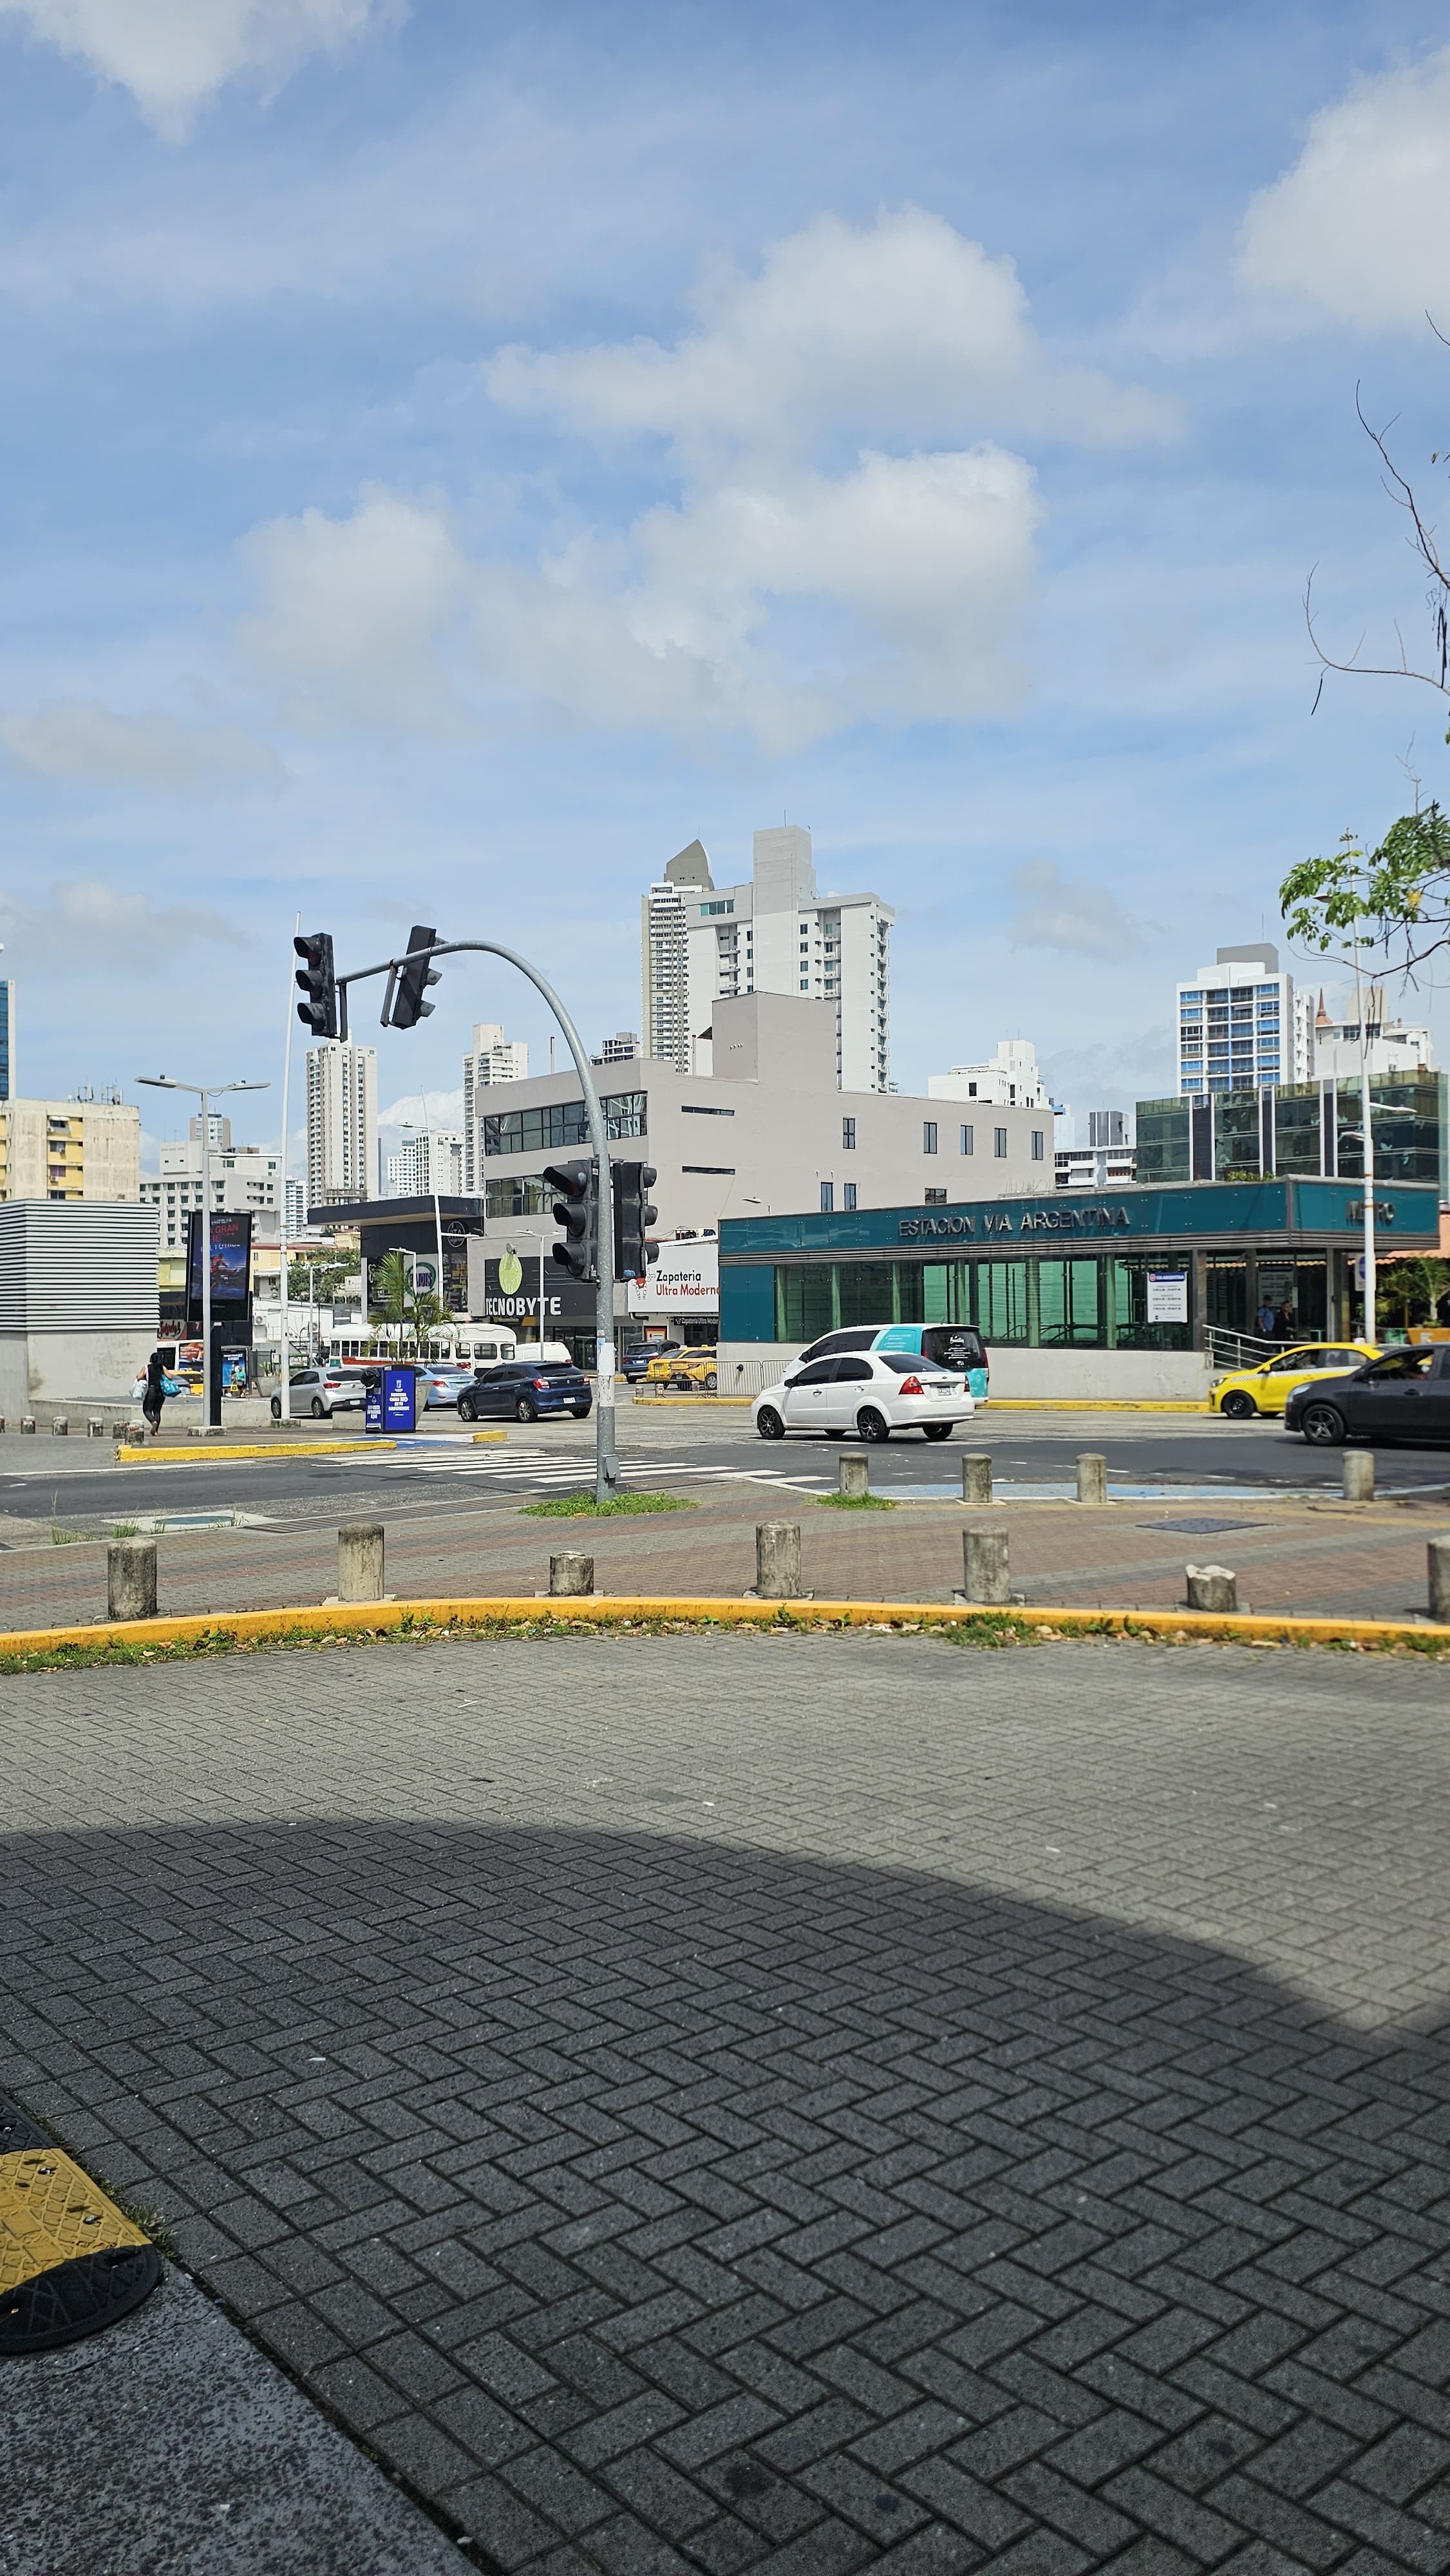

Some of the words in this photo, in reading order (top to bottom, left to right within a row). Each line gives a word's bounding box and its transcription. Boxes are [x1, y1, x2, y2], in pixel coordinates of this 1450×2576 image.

[1346, 1201, 1395, 1222] MERO
[216, 1223, 239, 1234] GRAN
[899, 1216, 975, 1236] ESTACION
[984, 1213, 1013, 1231] VIA
[1021, 1206, 1131, 1230] ARGENTINA
[657, 1270, 701, 1285] Zapateria
[657, 1284, 678, 1296] Ultra
[485, 1296, 561, 1316] TECNOBYTE
